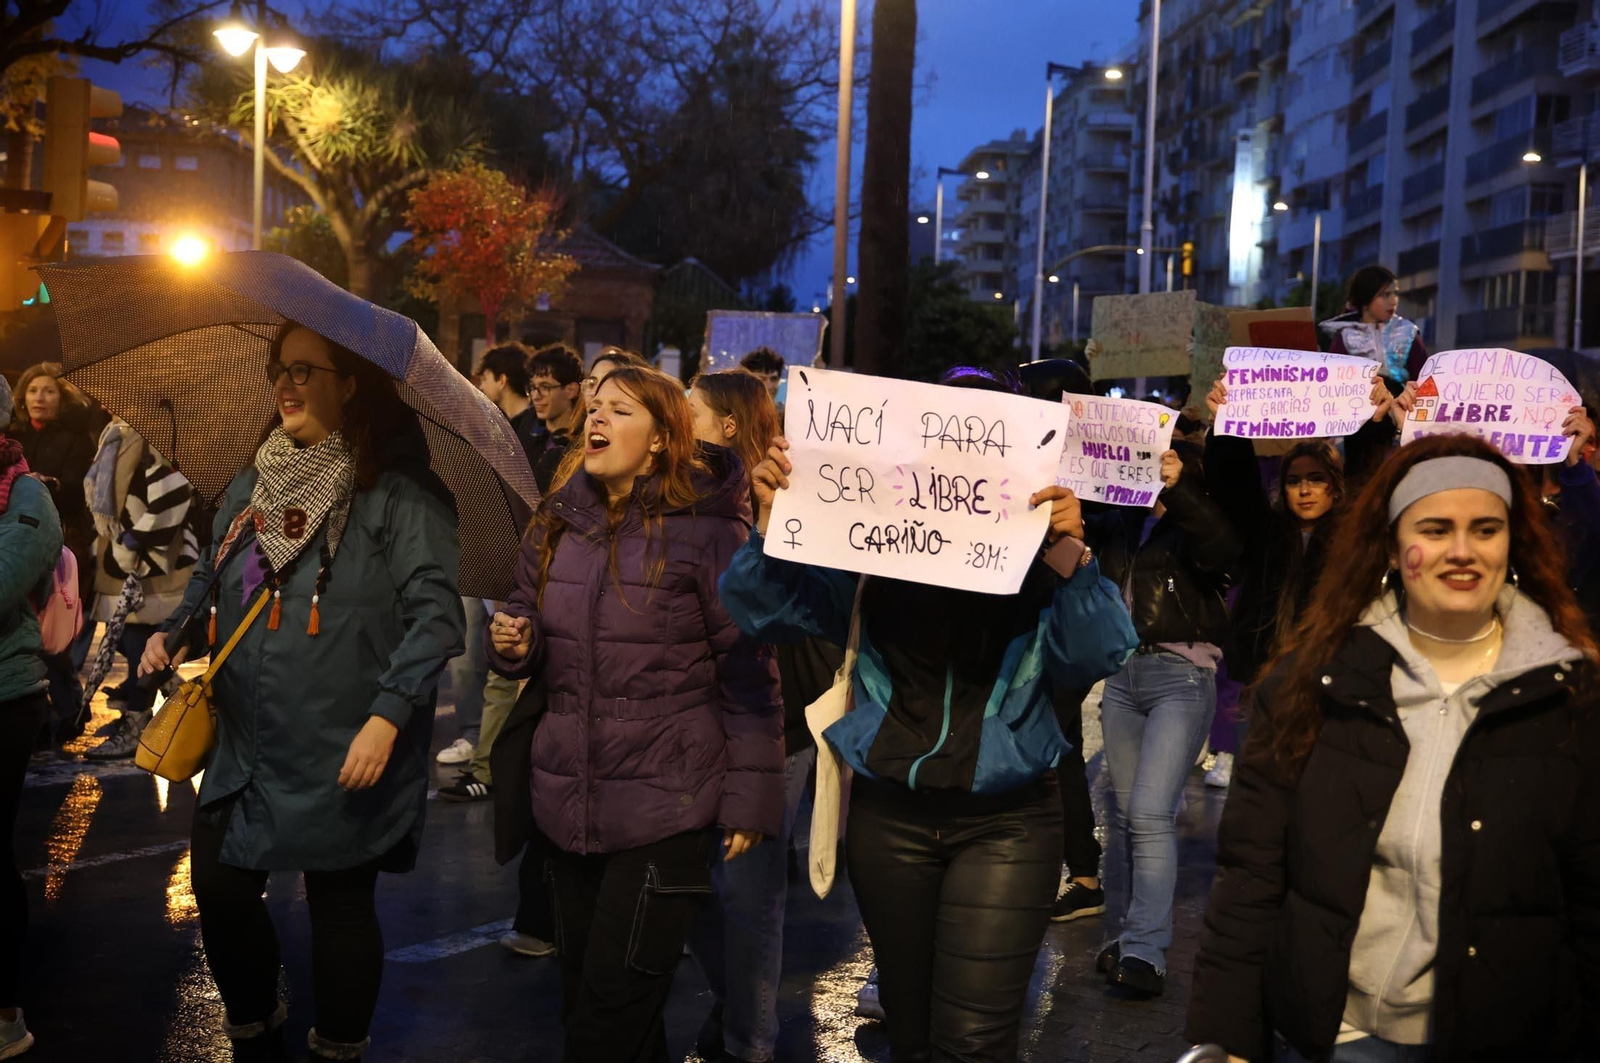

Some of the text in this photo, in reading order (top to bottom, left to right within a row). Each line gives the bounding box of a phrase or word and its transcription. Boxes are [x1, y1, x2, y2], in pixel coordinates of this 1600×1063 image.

[1228, 348, 1303, 363] OPINAS
[1420, 353, 1449, 377] DE
[1453, 351, 1538, 380] CAMINO
[1228, 364, 1329, 386] FEMINISMO
[1318, 383, 1367, 399] OLVIDAS
[1443, 380, 1561, 403] QUIERO SER
[1226, 398, 1338, 419] QUE GRACIAS AL
[921, 412, 1012, 457] PARA
[1077, 422, 1125, 443] MOTIVOS
[1224, 418, 1317, 437] FEMINISMO
[1082, 441, 1131, 462] HUELGA
[817, 464, 876, 504] SER
[1091, 461, 1111, 479] QUE
[1118, 464, 1154, 485] ERES
[849, 519, 952, 555] CARIÑO
[970, 542, 1001, 570] 8M
